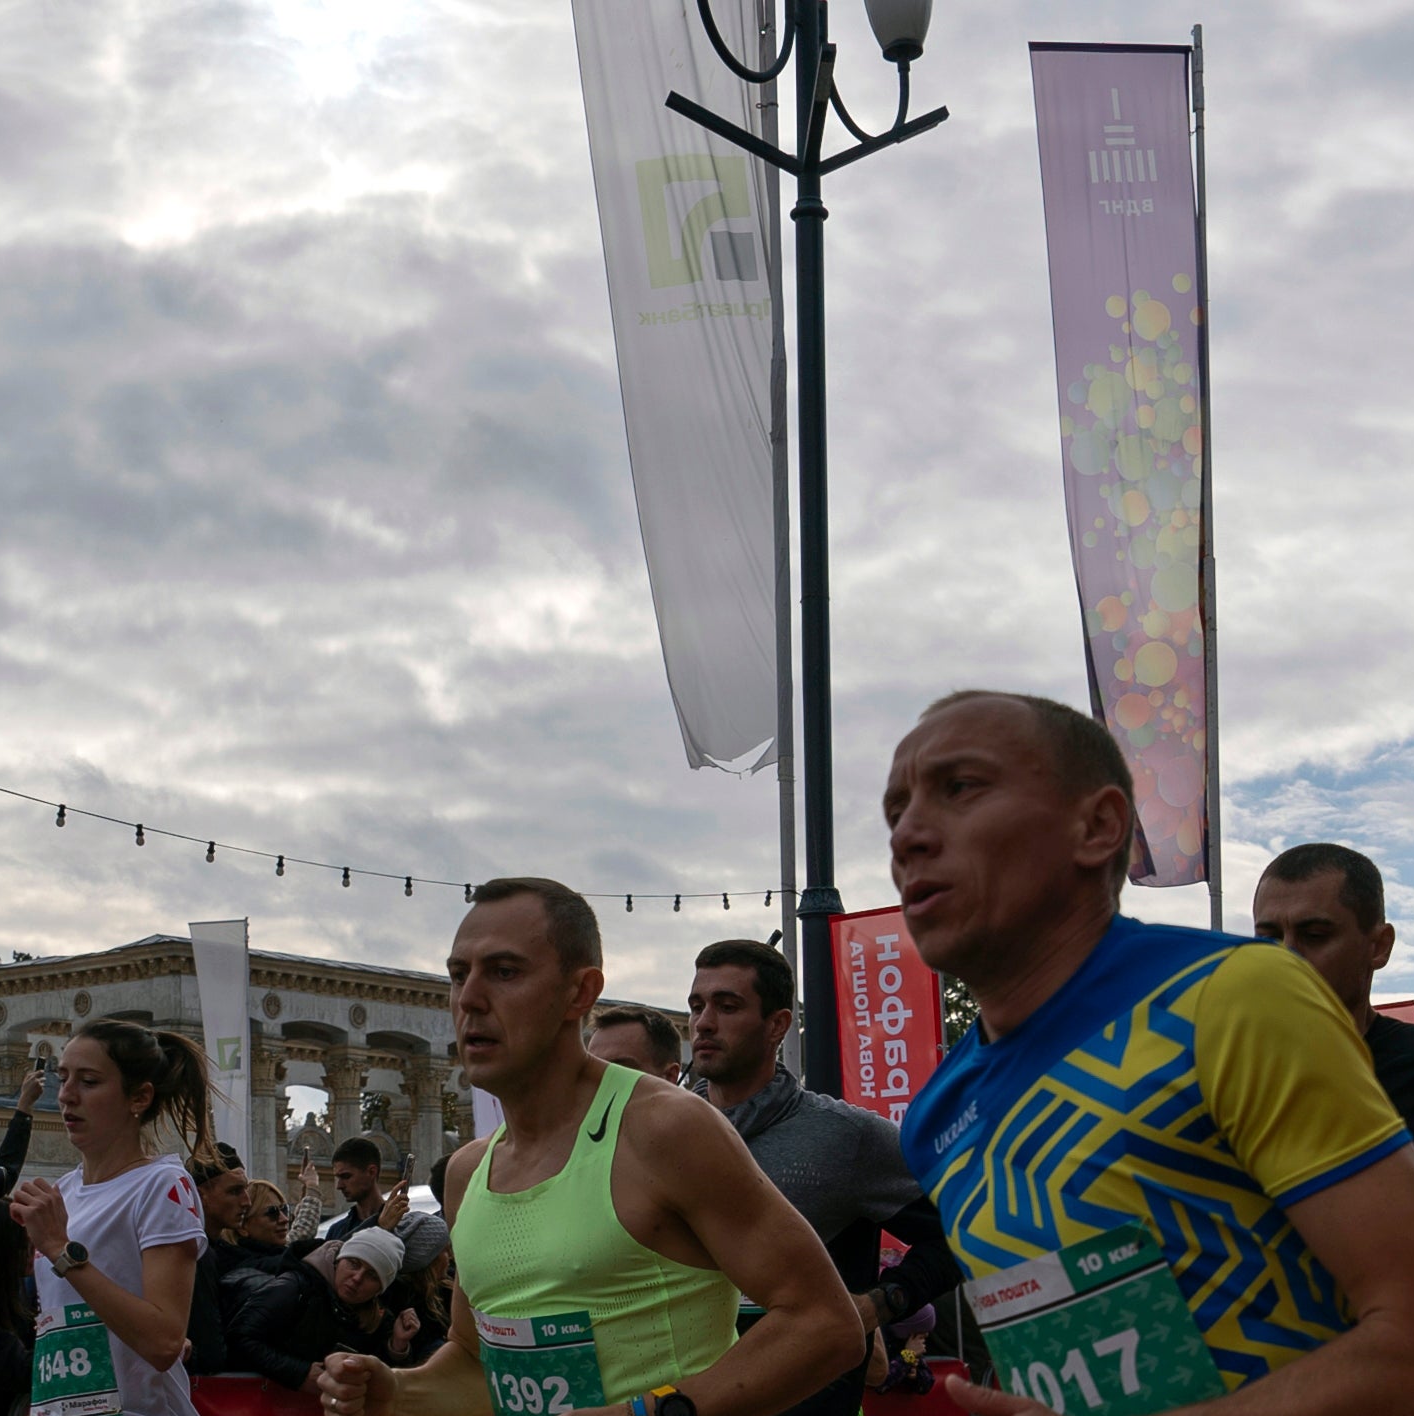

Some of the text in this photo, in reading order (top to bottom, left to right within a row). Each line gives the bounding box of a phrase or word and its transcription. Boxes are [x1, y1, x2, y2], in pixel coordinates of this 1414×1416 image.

[934, 1099, 979, 1155] UKRAINE
[1076, 1252, 1104, 1276] 10
[541, 1324, 557, 1337] 10
[39, 1347, 92, 1384] 1548
[491, 1371, 574, 1415] 1392
